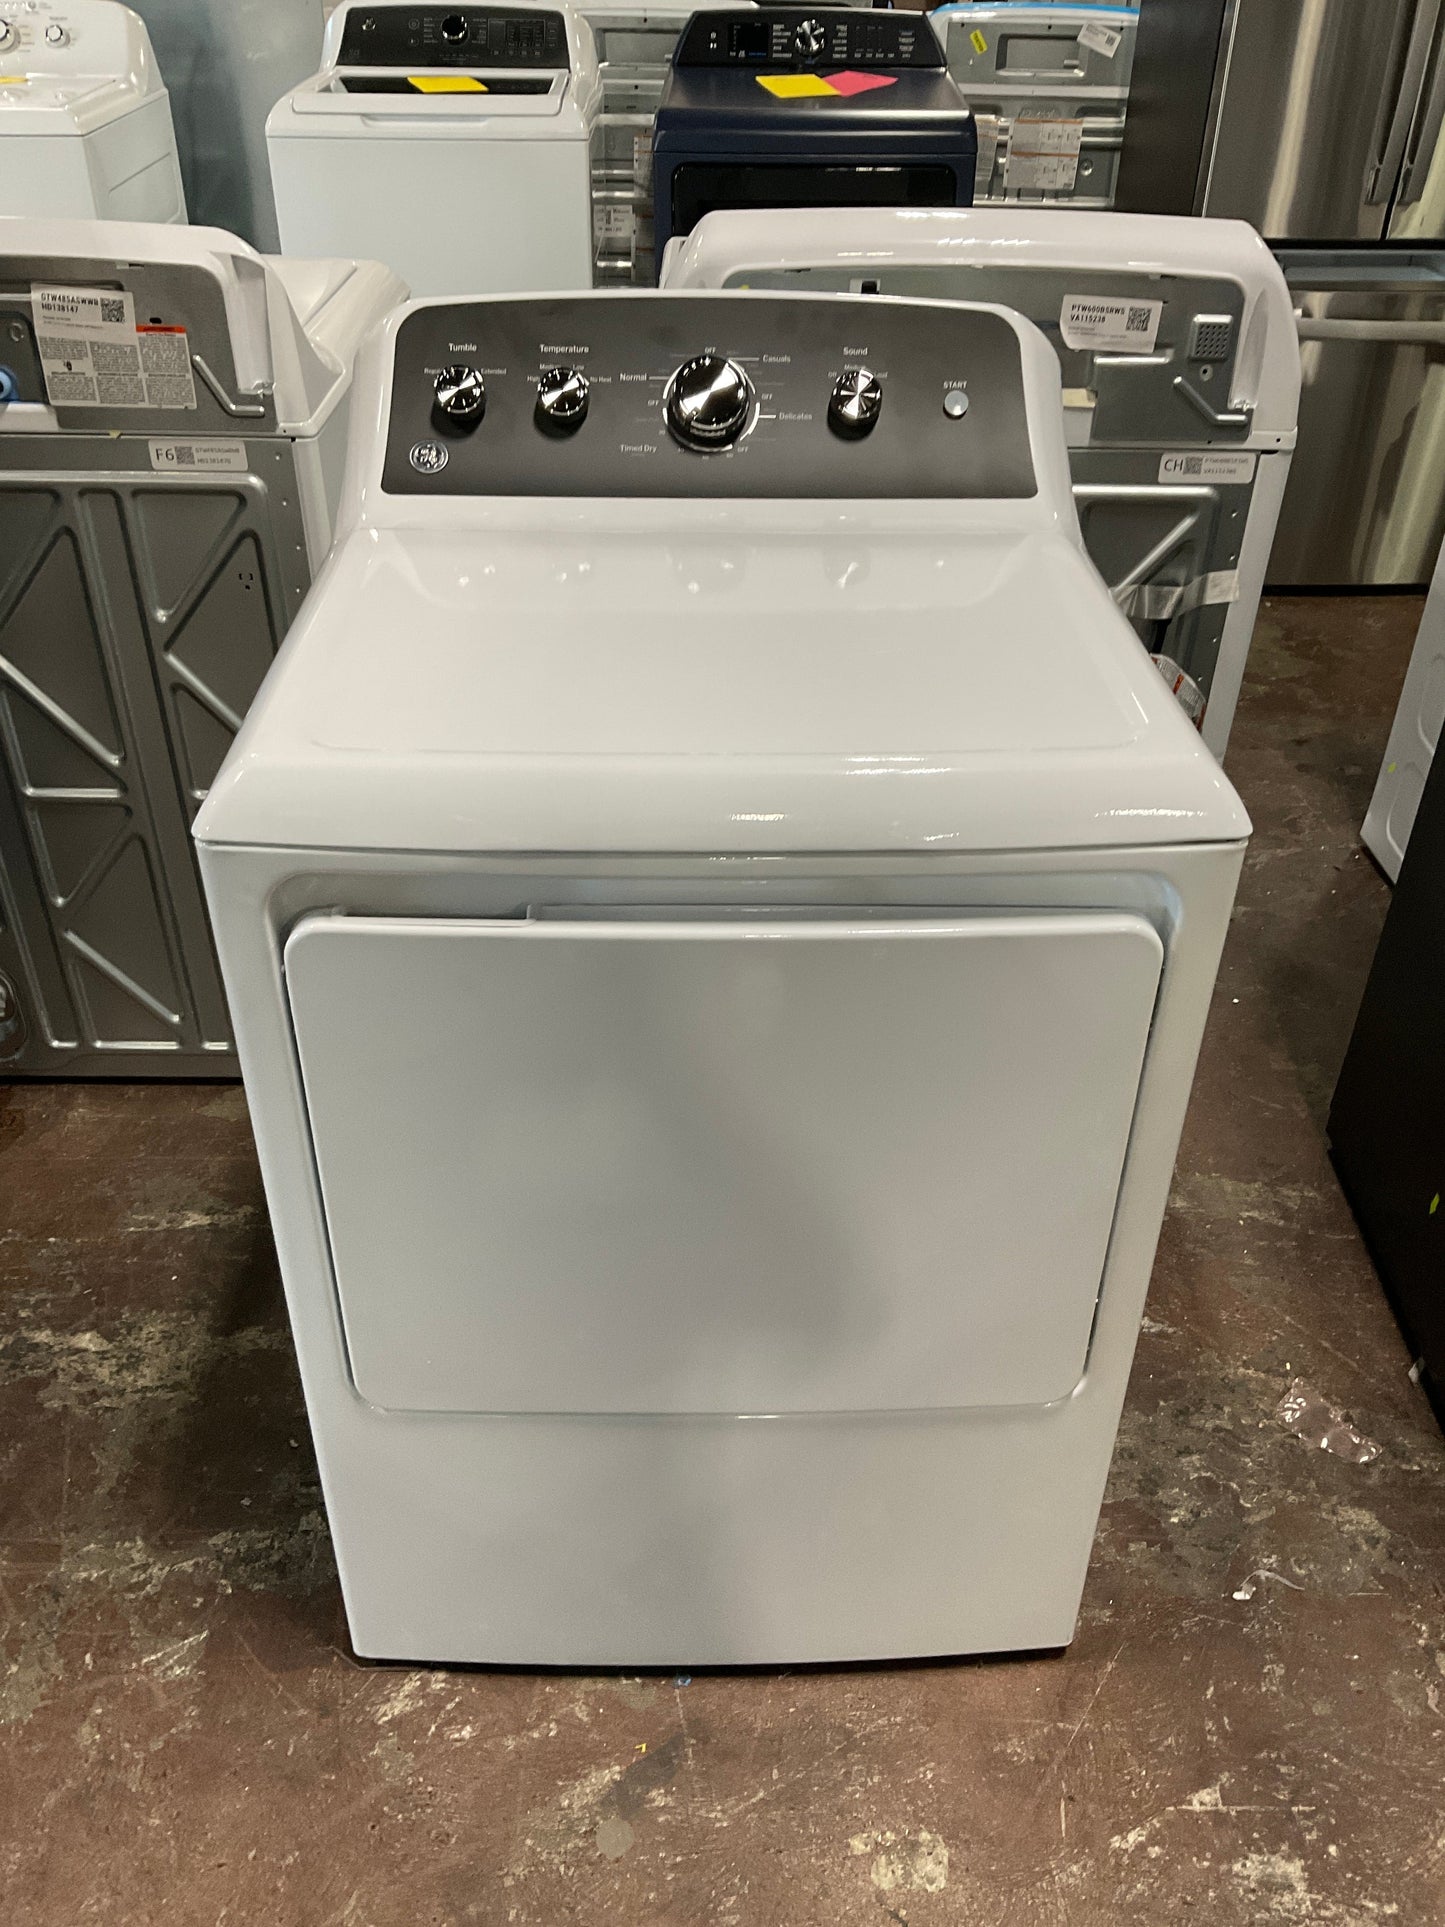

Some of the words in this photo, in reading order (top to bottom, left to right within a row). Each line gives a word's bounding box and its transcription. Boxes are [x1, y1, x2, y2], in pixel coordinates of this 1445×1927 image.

[448, 342, 477, 352] Tumble
[540, 344, 590, 354] Temperature
[704, 346, 717, 354] OFF
[843, 347, 868, 356] Sound
[762, 354, 791, 363] Casuals
[619, 372, 648, 381] Normal
[943, 380, 968, 389] START
[779, 411, 813, 420] Delicates
[620, 444, 643, 453] Timed
[643, 444, 657, 453] Dry
[155, 447, 175, 461] F6
[1164, 459, 1184, 472] CH
